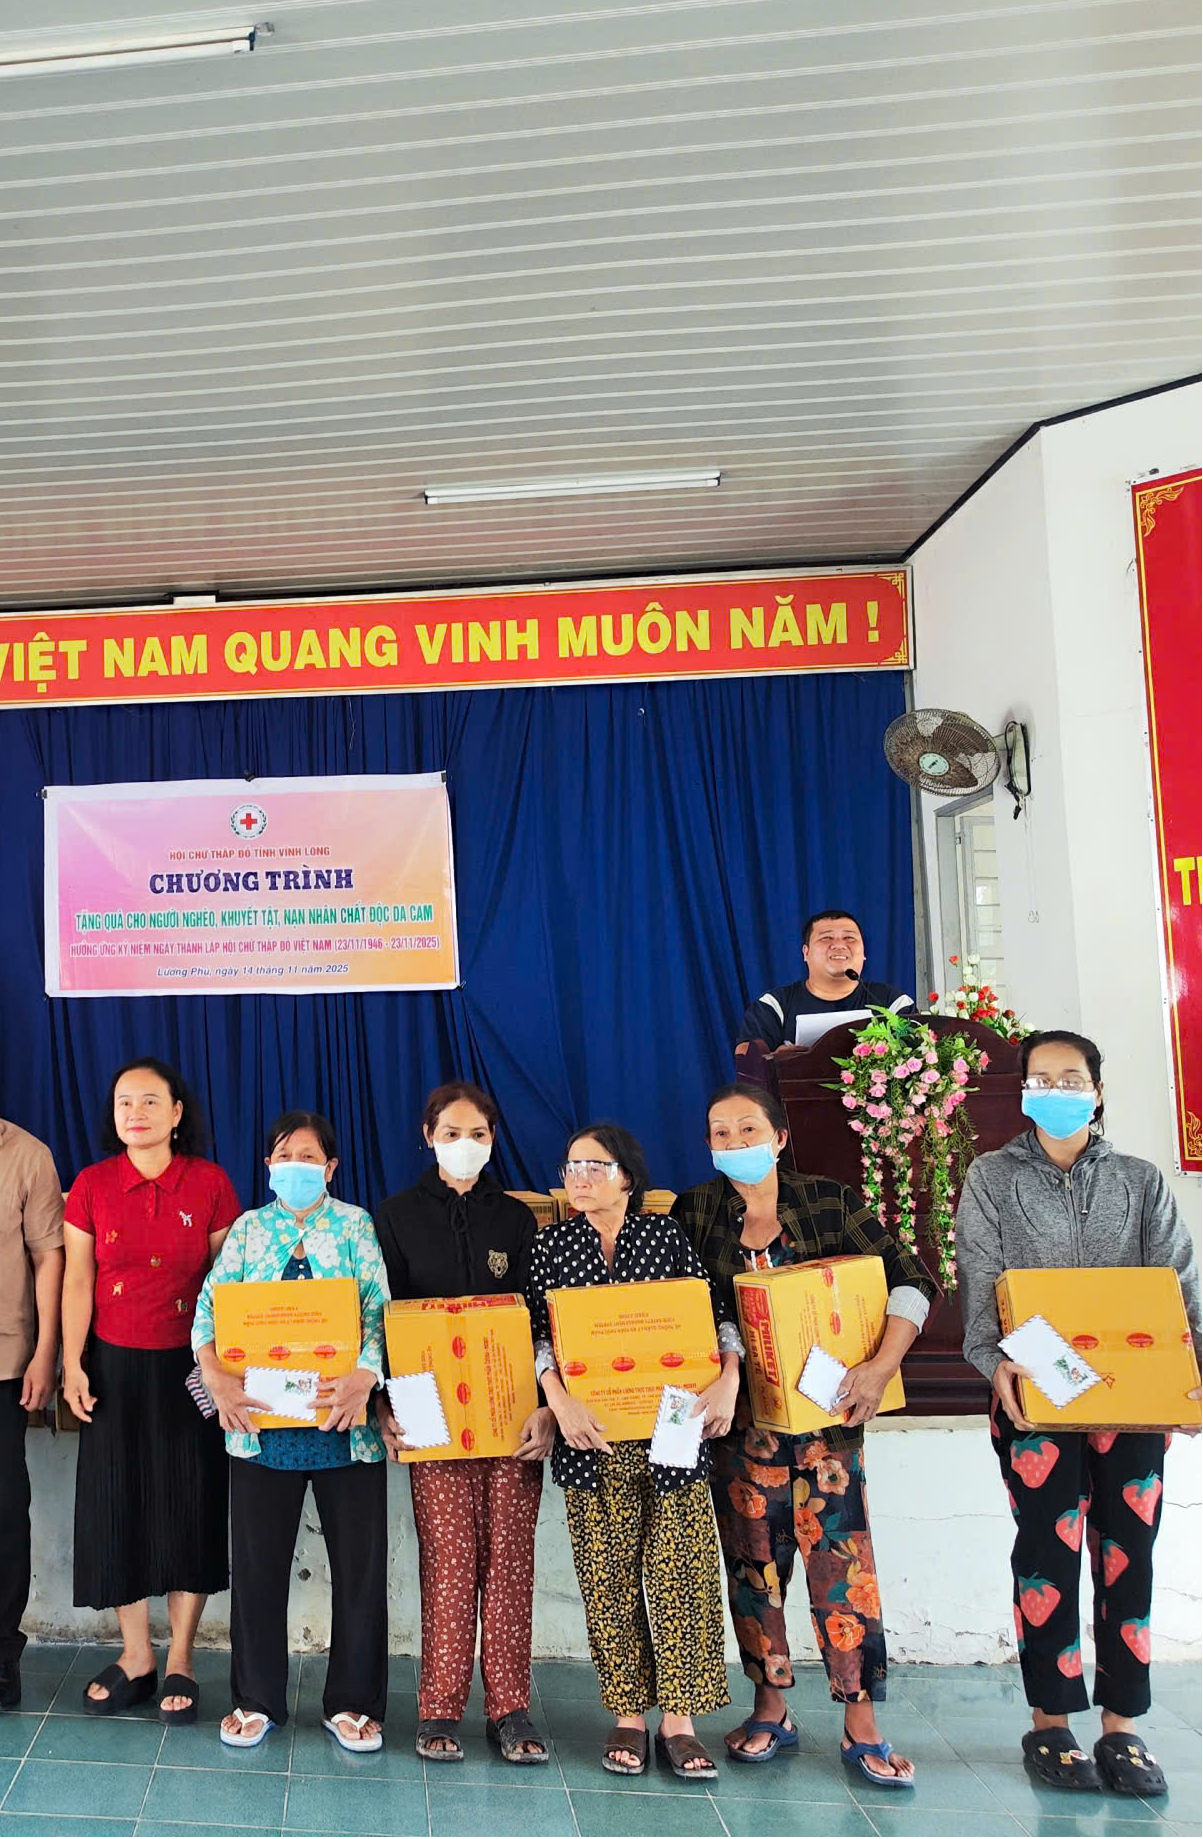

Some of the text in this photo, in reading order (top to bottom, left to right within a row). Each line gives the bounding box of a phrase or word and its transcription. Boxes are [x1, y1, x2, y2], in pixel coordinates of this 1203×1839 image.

[104, 634, 208, 678] NAM
[224, 625, 398, 674] QUANG
[415, 619, 539, 664] VINH
[558, 602, 710, 658] MUÔN
[730, 595, 847, 648] NĂM
[867, 601, 879, 642] !
[304, 847, 330, 857] LONG
[149, 864, 354, 894] CHƯƠNG TRÌNH
[1173, 856, 1202, 906] T
[126, 912, 146, 929] CHO
[149, 908, 179, 929] NGƯỜI
[221, 905, 259, 927] KHUYẾT
[284, 907, 306, 929] NẠN
[308, 905, 337, 925] NHÂN
[340, 901, 366, 924] CHẤT
[369, 902, 390, 926] ĐỘC
[393, 905, 407, 922] DA
[409, 904, 433, 922] CAM
[312, 938, 332, 951] NAM
[243, 966, 253, 975] 14
[287, 965, 298, 974] 11
[325, 964, 349, 973] 2025
